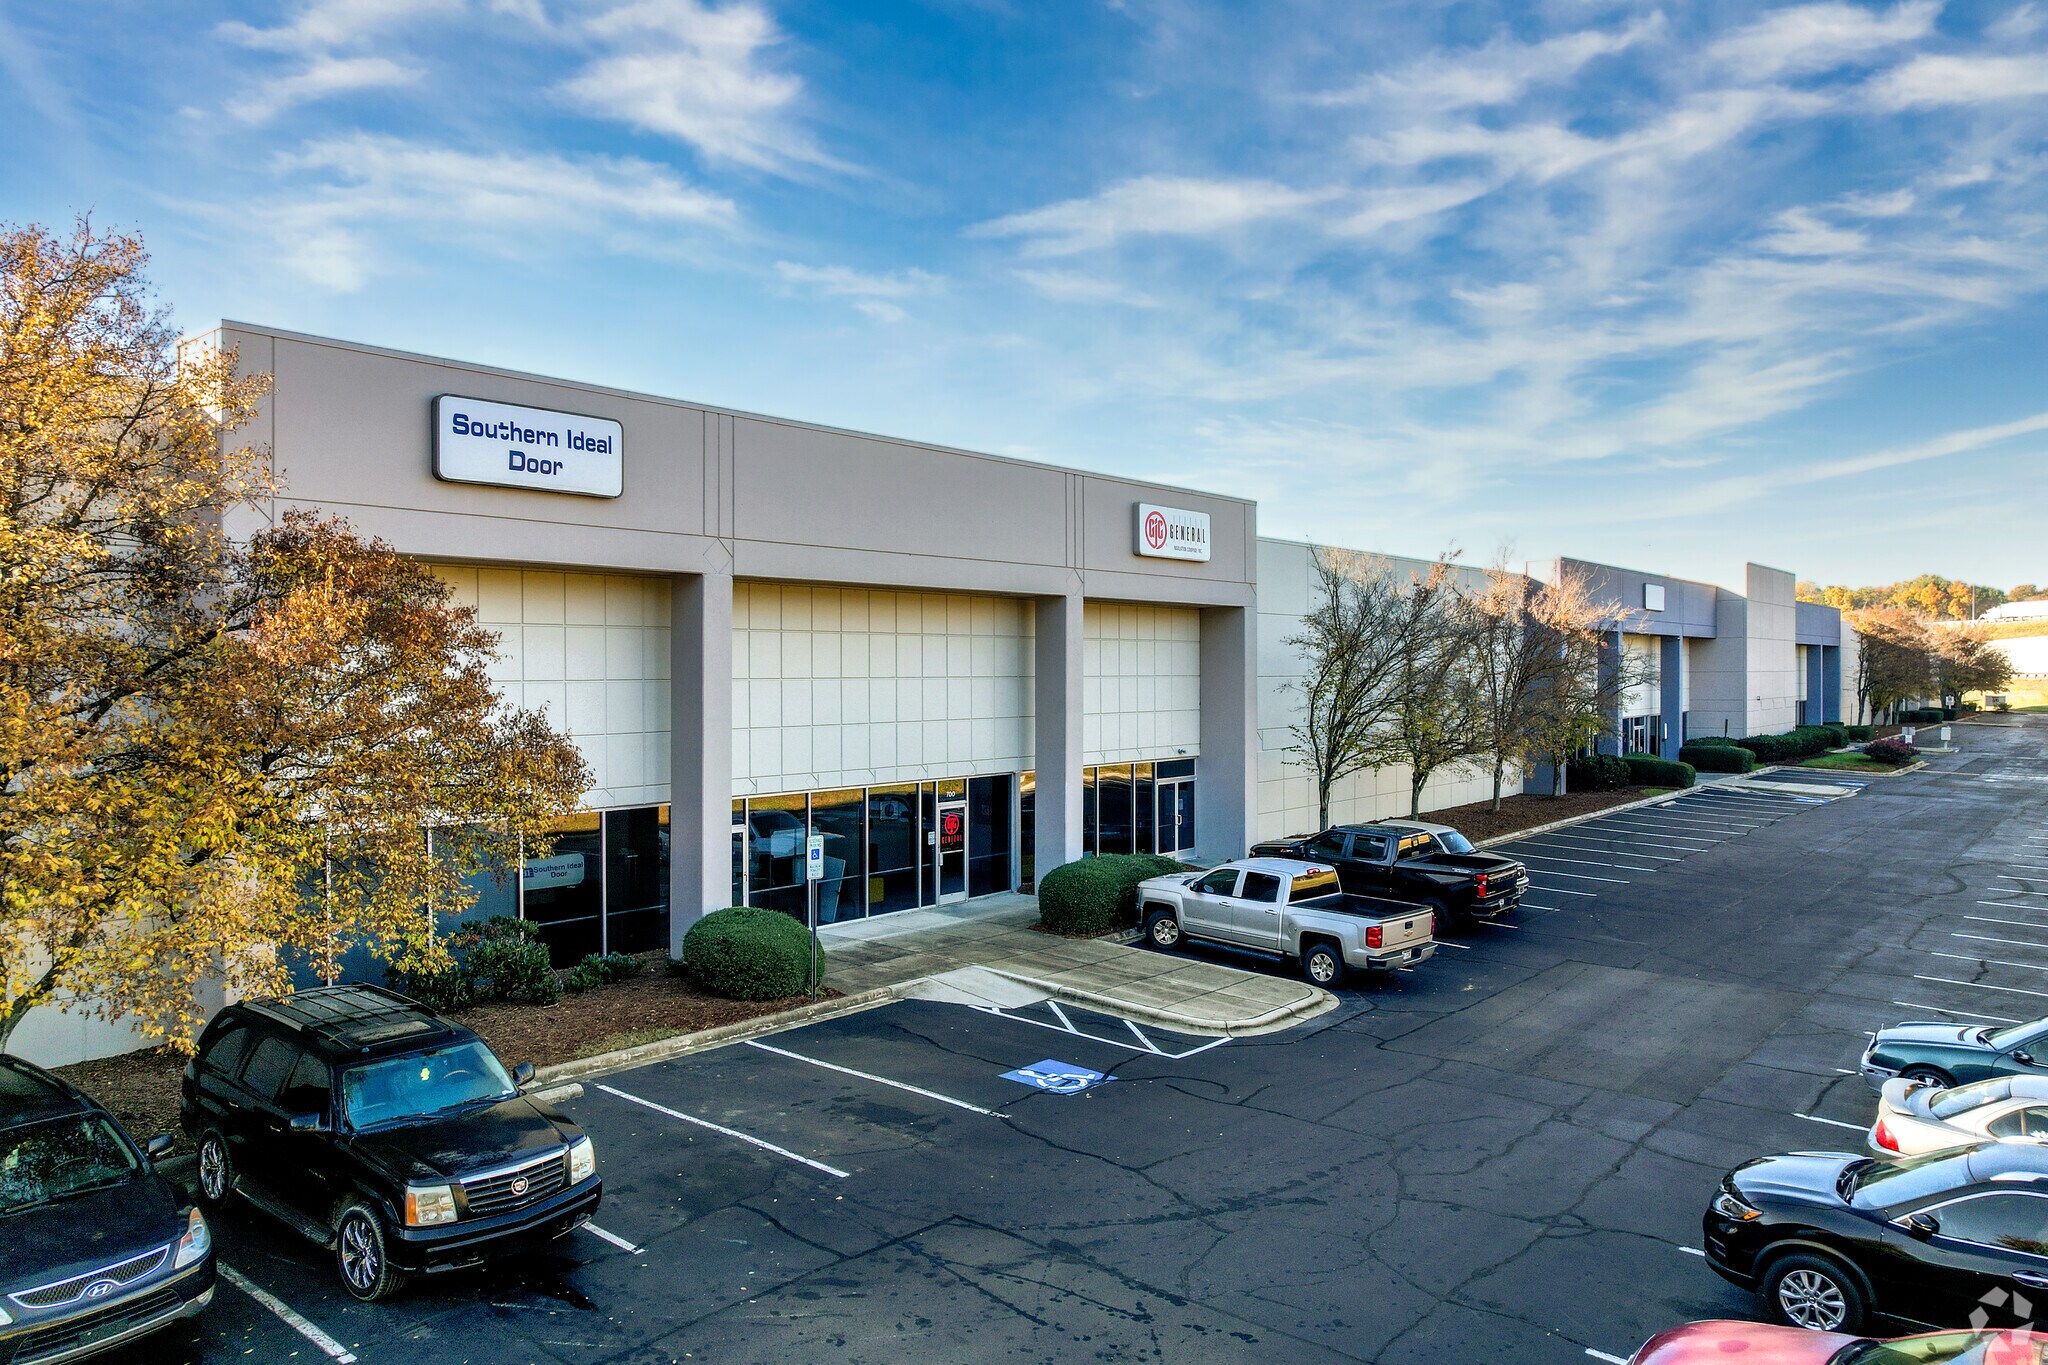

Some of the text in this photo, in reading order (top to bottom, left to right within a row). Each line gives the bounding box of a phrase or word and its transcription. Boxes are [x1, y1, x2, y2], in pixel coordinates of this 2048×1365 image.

[452, 413, 612, 454] Southern Ideal
[508, 449, 563, 475] Door
[1169, 524, 1205, 543] GENERAL
[533, 864, 566, 873] Southern
[567, 861, 583, 869] Ideal
